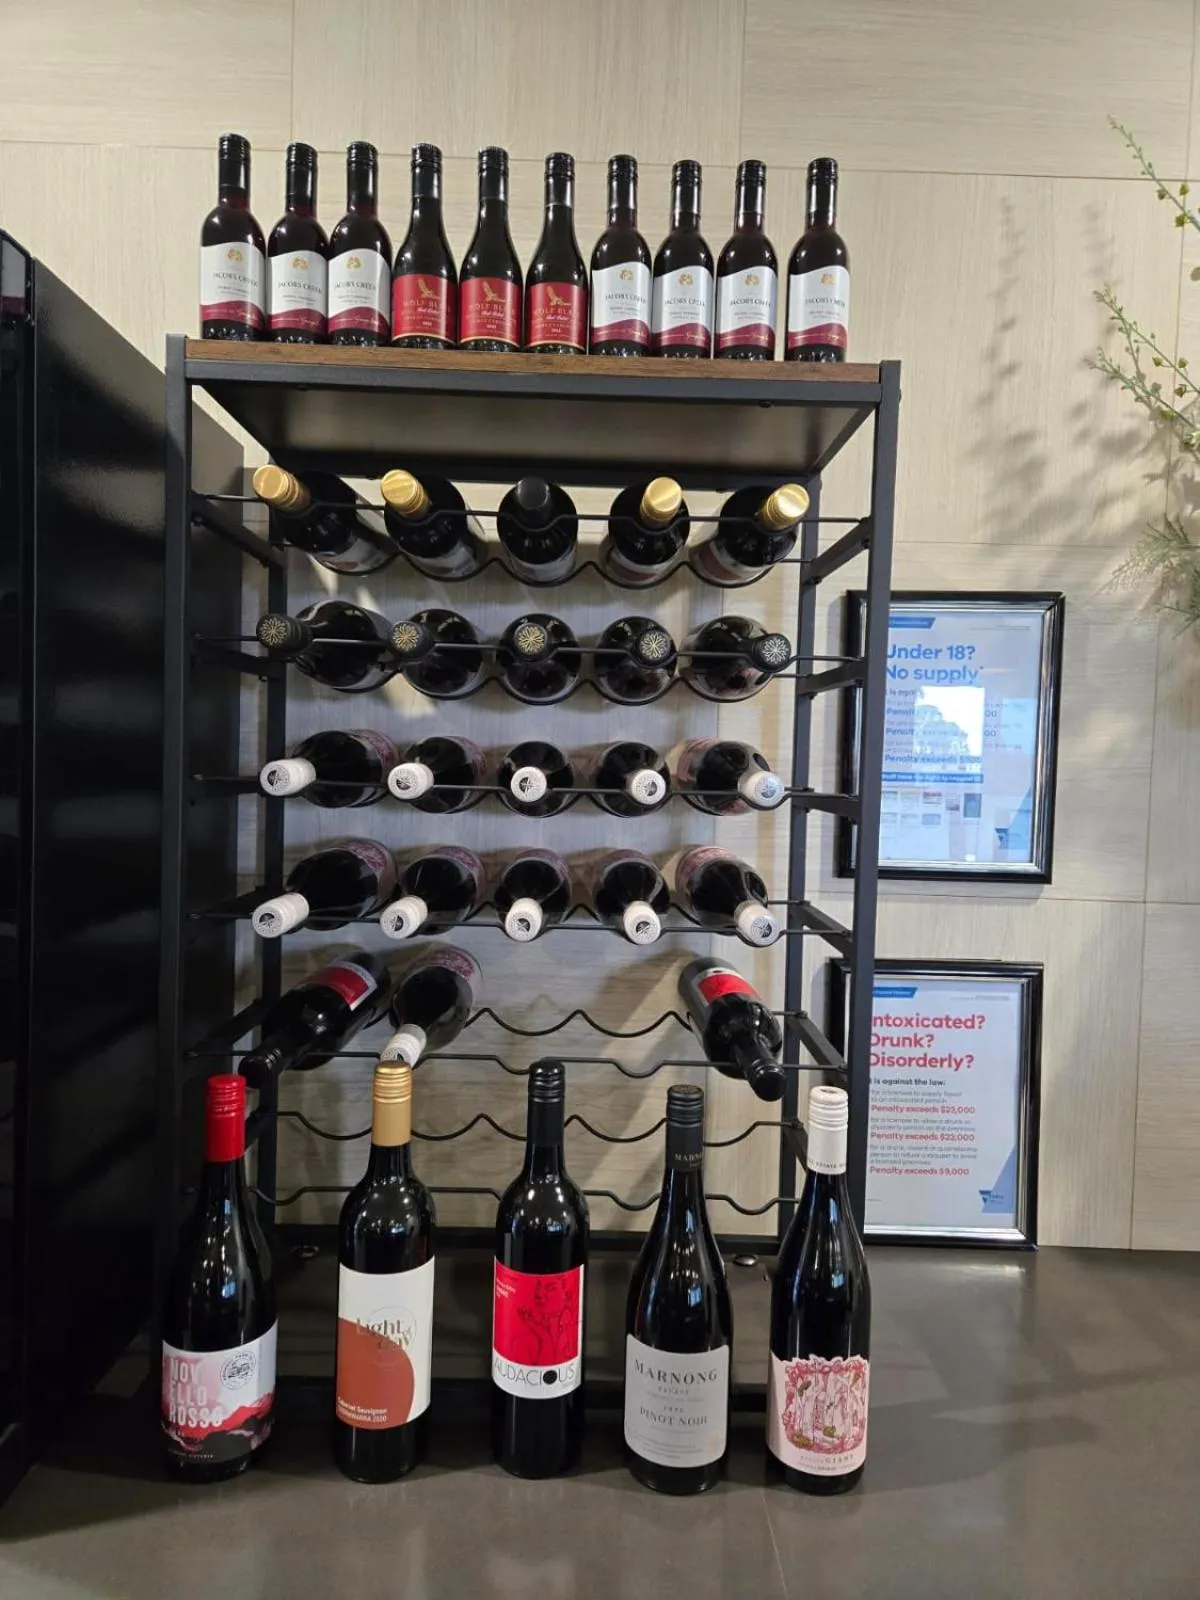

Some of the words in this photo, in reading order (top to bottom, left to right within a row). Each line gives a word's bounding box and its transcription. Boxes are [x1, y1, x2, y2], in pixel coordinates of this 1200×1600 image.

[887, 643, 942, 660] Under
[946, 644, 976, 661] 18?
[887, 664, 909, 680] No
[872, 1012, 986, 1029] ntoxicated?
[871, 1032, 935, 1048] Drunk?
[869, 1051, 975, 1072] Disorderly?
[882, 1078, 912, 1086] against
[871, 1104, 904, 1113] Penalty
[906, 1105, 939, 1113] exceeds
[870, 1131, 903, 1141] Penalty
[905, 1132, 939, 1140] exceeds
[869, 1165, 902, 1176] Penalty
[904, 1167, 937, 1176] exceeds
[635, 1358, 718, 1386] MARNONG
[640, 1406, 674, 1426] PINOT
[679, 1414, 708, 1426] NOIR
